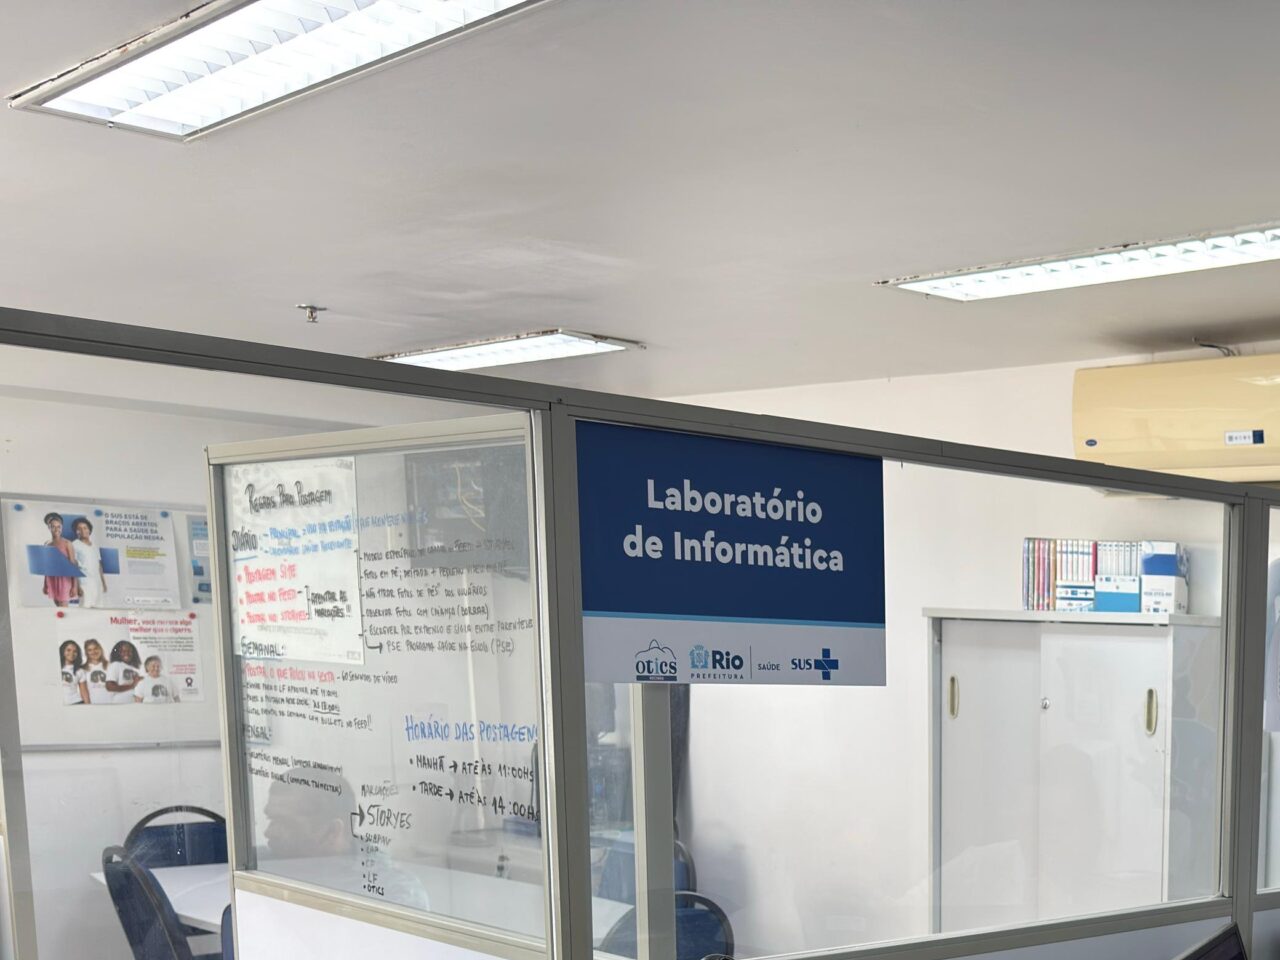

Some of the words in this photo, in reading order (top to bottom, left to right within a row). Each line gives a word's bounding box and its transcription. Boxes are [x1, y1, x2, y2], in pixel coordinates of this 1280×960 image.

[647, 479, 823, 524] Laboratório
[623, 525, 663, 559] de
[674, 530, 844, 571] Informática
[635, 658, 677, 675] otics
[711, 650, 744, 670] Rio
[758, 661, 780, 671] SAÚDE
[791, 658, 812, 670] SUS
[405, 714, 449, 742] HORÁRIO
[454, 721, 475, 740] DAS
[419, 781, 443, 798] TARDE
[367, 804, 412, 829] STORYES
[367, 883, 384, 896] OTICS
